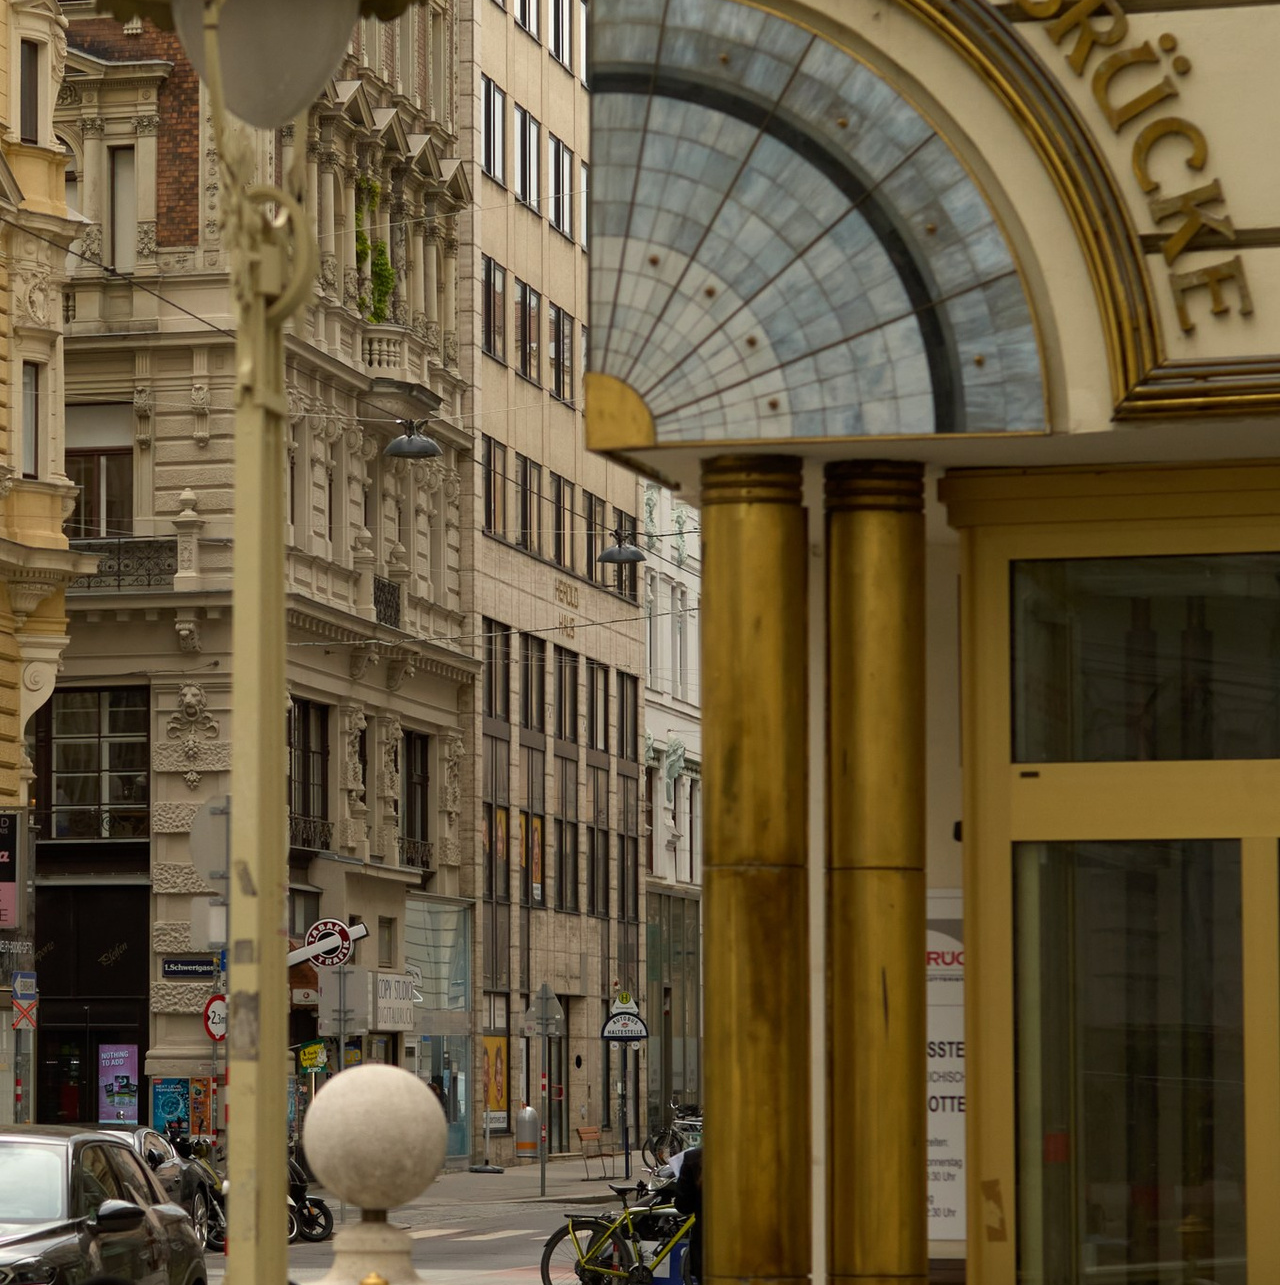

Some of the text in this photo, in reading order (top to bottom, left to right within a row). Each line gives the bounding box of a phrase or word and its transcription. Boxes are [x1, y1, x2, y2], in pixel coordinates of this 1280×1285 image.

[308, 922, 342, 943] TABAK
[318, 940, 350, 965] TRAFIK
[926, 951, 965, 965] RÜC
[378, 979, 413, 1001] COPY STUDIO
[612, 1015, 639, 1027] AUTOBUS
[101, 1051, 129, 1059] NOTHING
[927, 1041, 965, 1058] SSTE
[928, 1096, 966, 1112] OTTE
[926, 1157, 962, 1169] onnerstag
